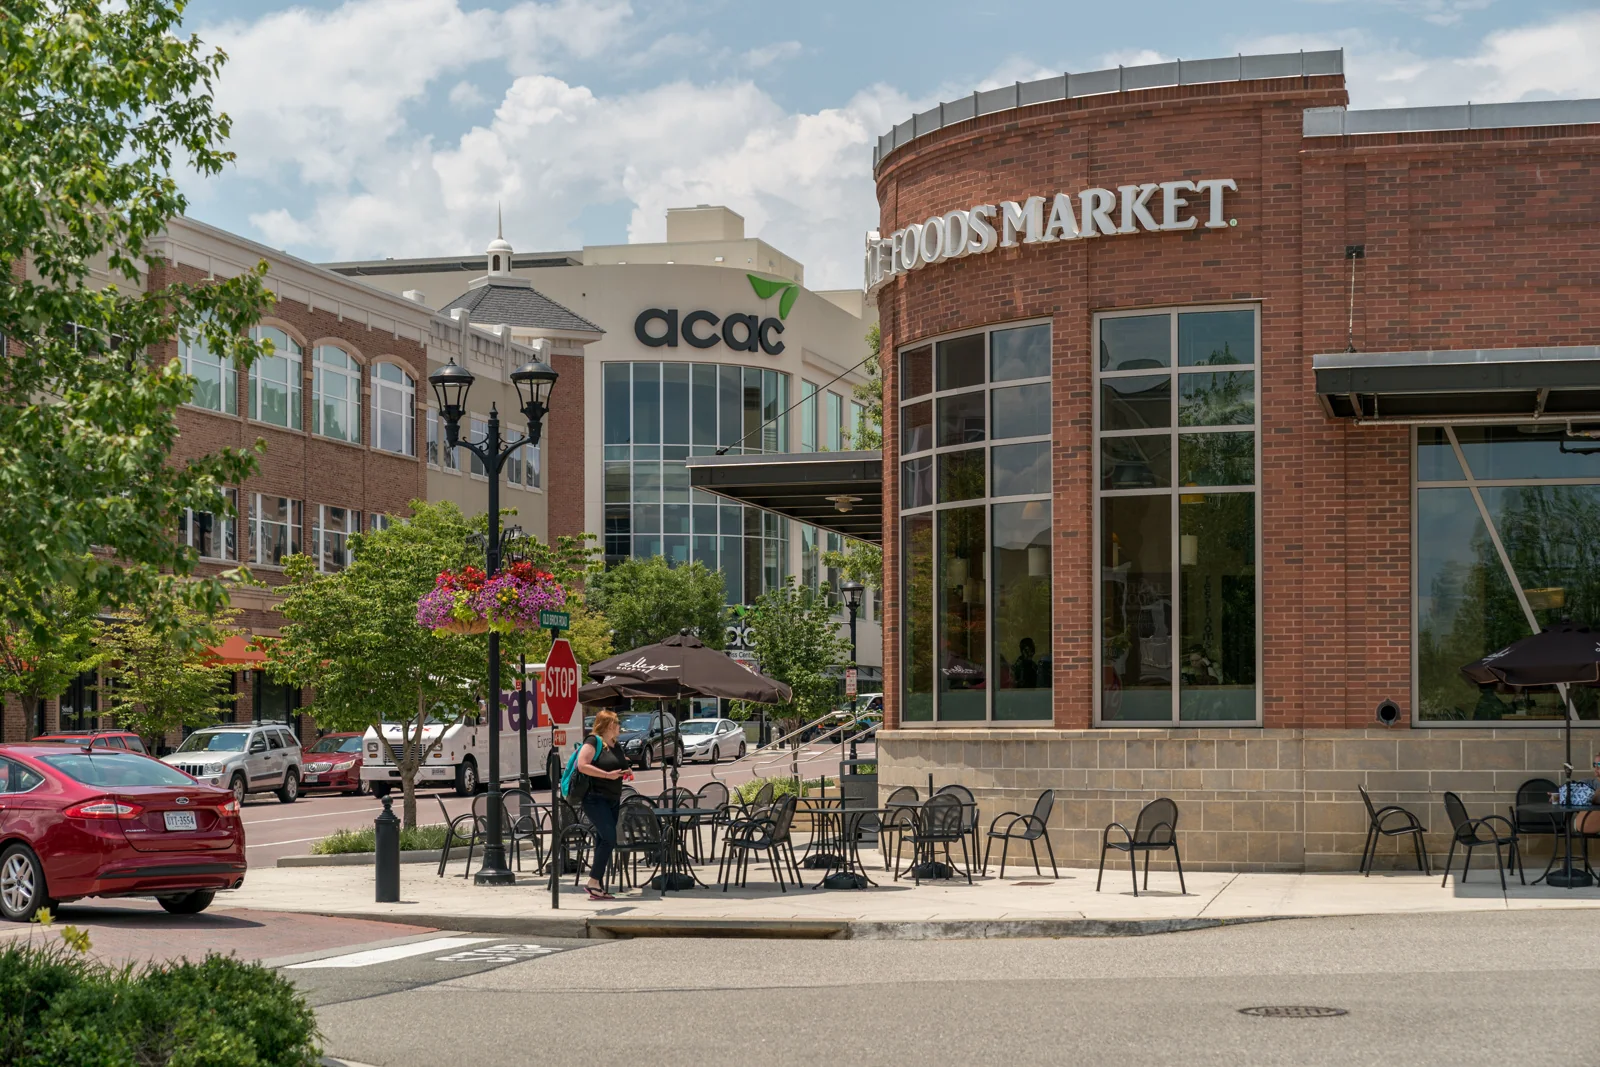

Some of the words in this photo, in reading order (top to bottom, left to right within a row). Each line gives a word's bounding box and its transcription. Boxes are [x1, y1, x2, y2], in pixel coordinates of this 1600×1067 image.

[889, 204, 998, 275] FOODS
[1000, 178, 1238, 248] MARKET
[634, 308, 785, 355] acac
[723, 626, 758, 647] ac
[546, 666, 576, 698] STOP
